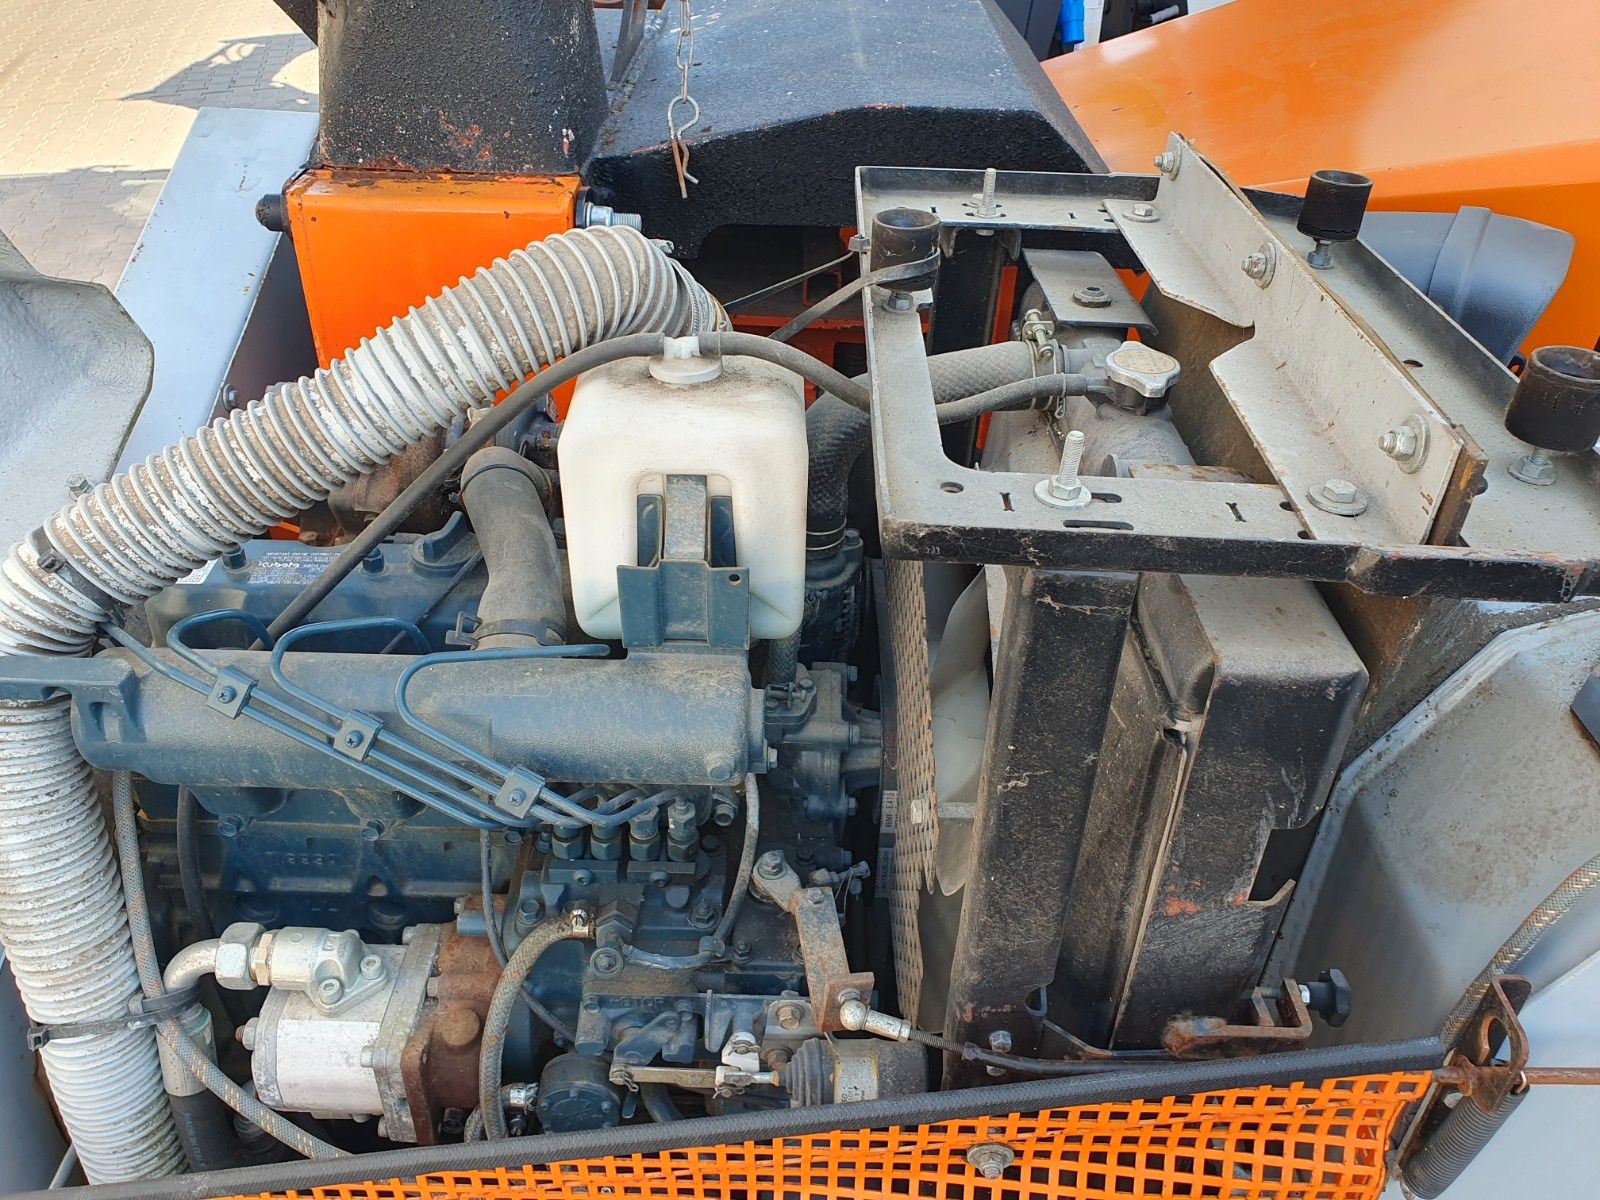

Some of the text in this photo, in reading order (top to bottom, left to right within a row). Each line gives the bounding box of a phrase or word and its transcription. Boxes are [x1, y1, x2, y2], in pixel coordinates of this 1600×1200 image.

[258, 560, 300, 568] Kubota
[183, 1112, 196, 1138] MADE
[192, 1147, 208, 1169] ITALY
